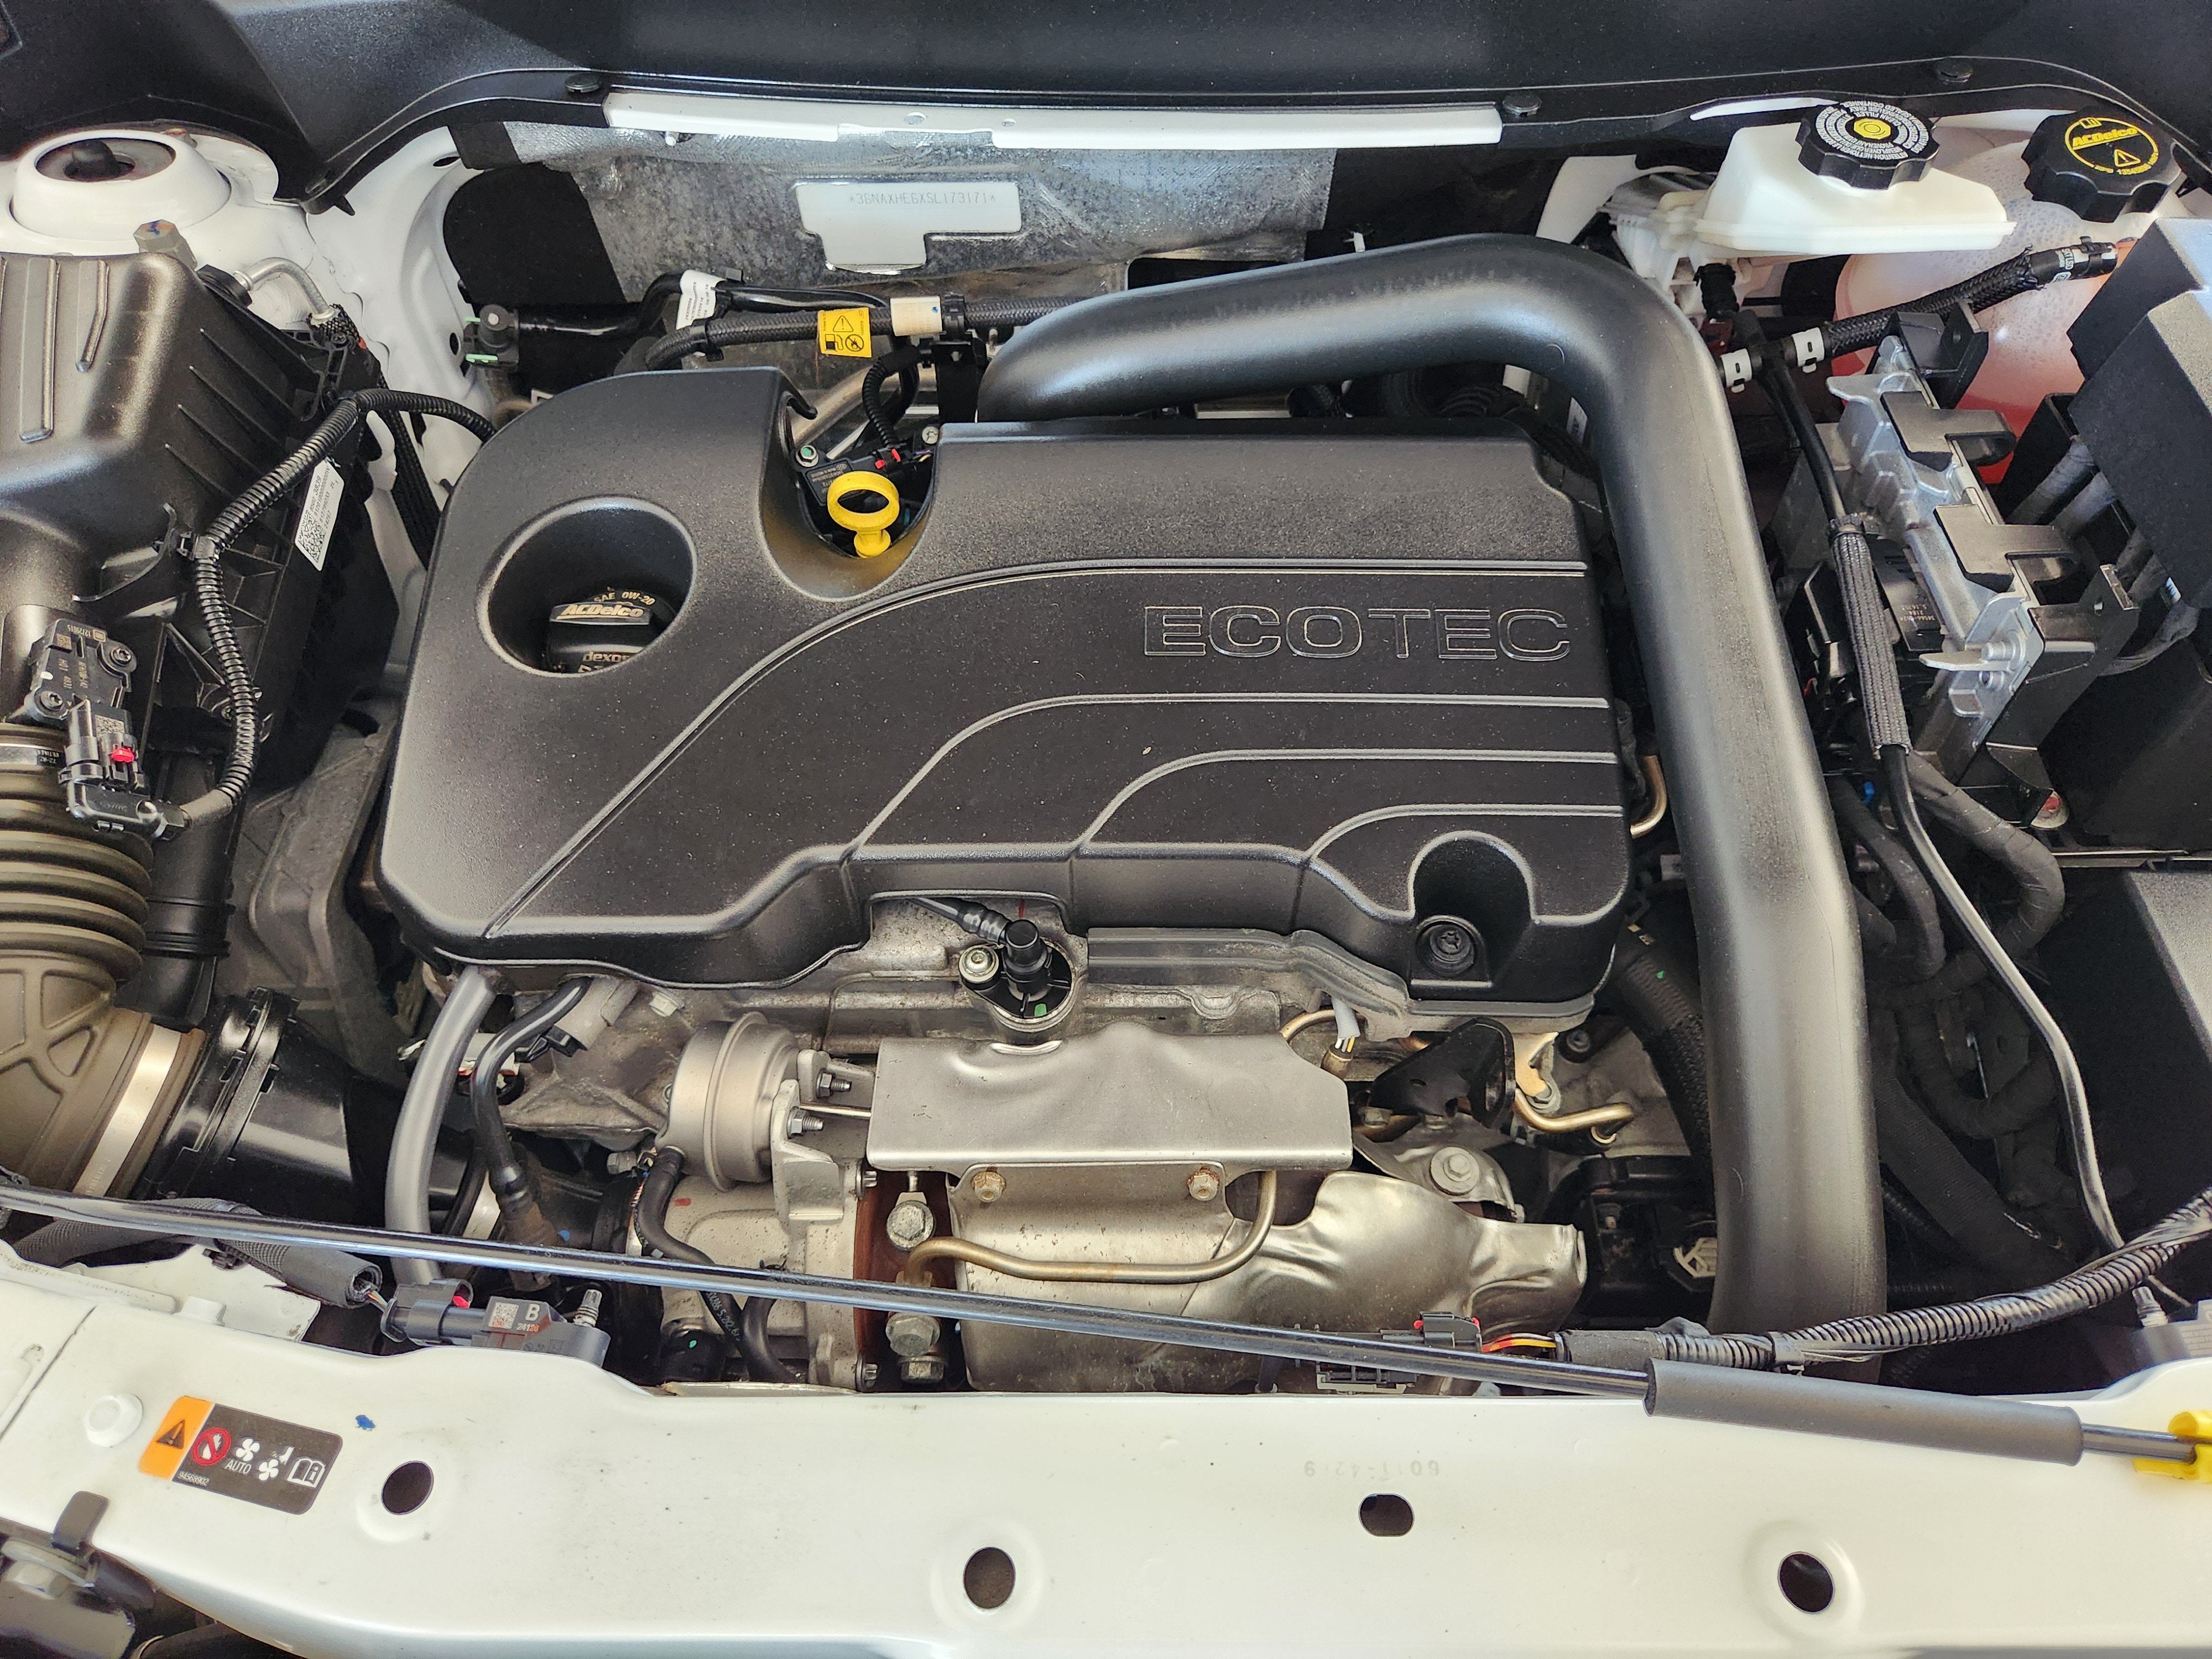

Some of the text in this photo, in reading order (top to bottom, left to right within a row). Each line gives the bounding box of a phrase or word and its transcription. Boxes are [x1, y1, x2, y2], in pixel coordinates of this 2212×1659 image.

[2073, 128, 2138, 147] ACDelco
[312, 474, 322, 496] 3839
[593, 591, 656, 606] SAE 0W-20
[560, 603, 644, 618] ACDelco
[1144, 604, 1571, 662] ECOTEC
[525, 1303, 540, 1321] B
[224, 1459, 252, 1475] AUTO
